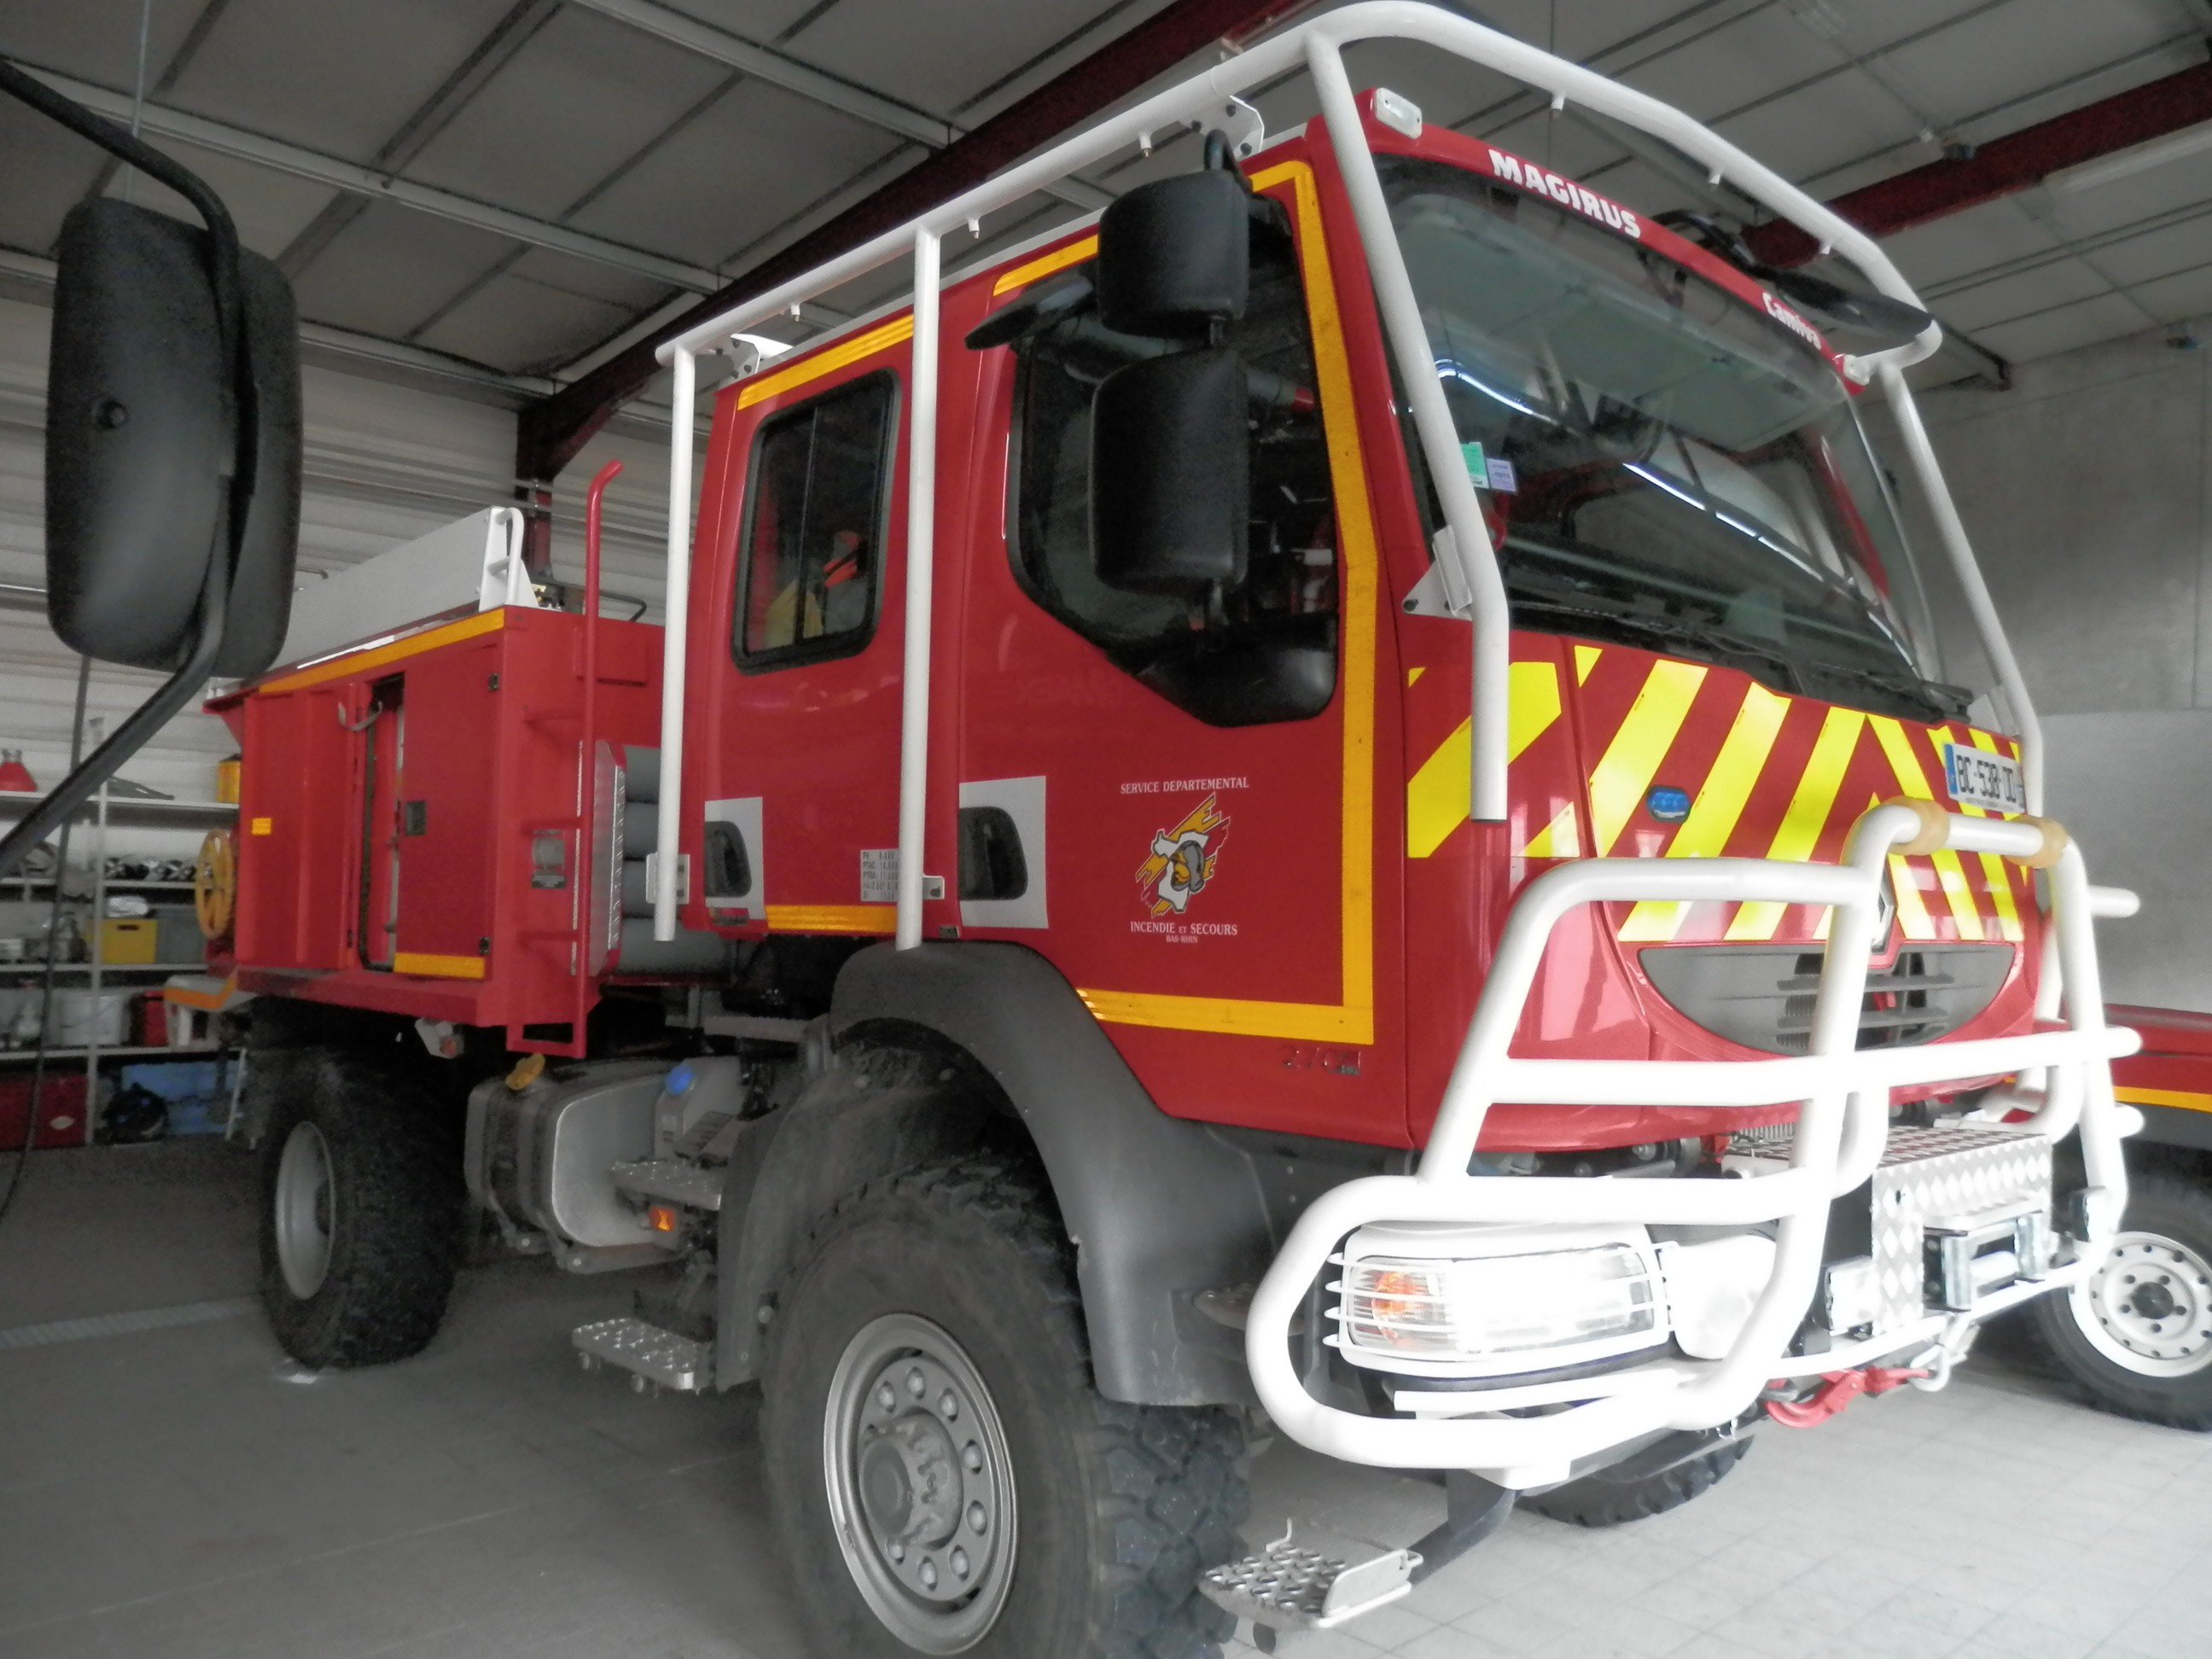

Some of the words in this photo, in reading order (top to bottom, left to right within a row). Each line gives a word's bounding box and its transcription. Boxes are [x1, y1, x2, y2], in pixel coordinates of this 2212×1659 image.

[1488, 148, 1641, 239] MAGIRUS
[1120, 782, 1160, 795] SERVICE
[1162, 777, 1249, 792] DEPARTEMENTAL
[1130, 921, 1176, 934] INCENDIE
[1190, 923, 1237, 936] SECOURS
